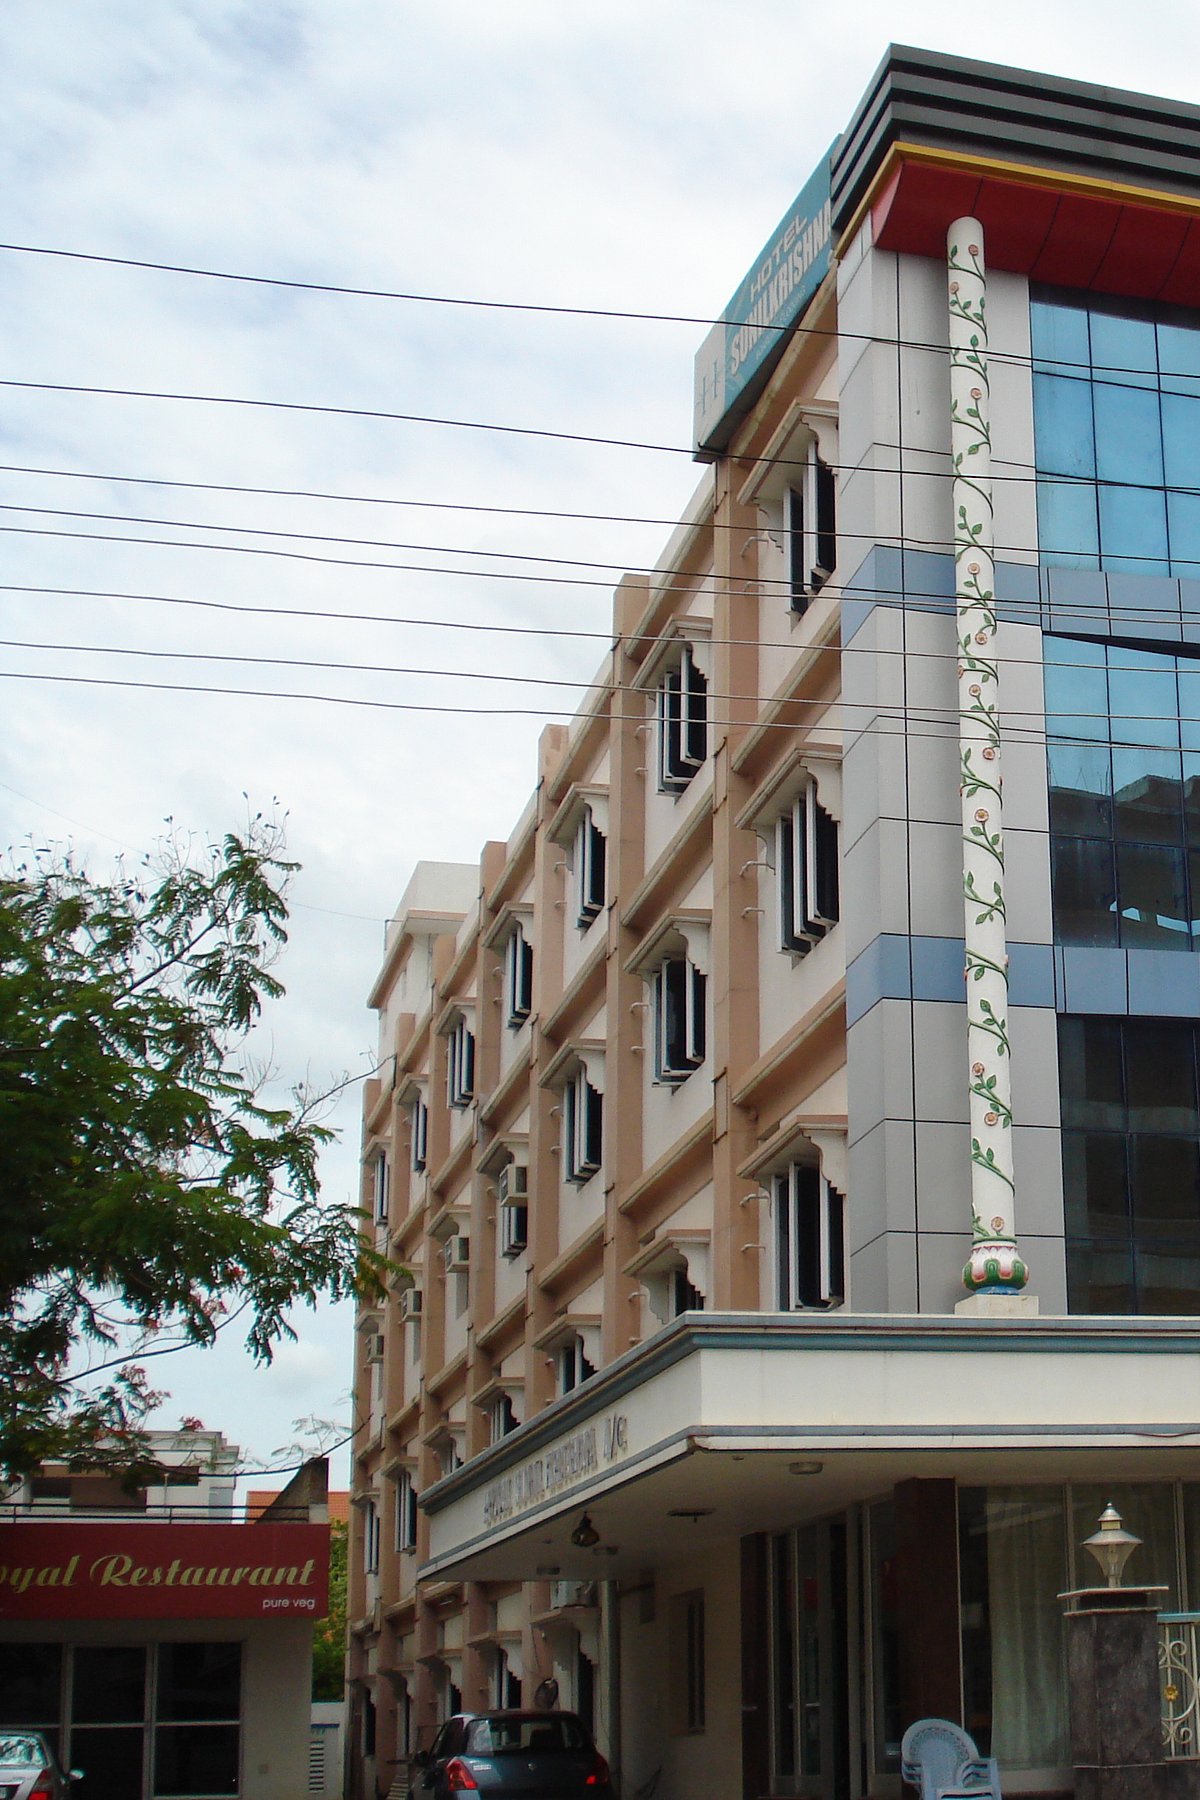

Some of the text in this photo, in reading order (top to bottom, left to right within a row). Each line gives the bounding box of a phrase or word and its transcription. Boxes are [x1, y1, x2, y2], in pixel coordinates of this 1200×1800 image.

[751, 213, 808, 300] HOTEL
[89, 1554, 315, 1588] Restaurant
[262, 1598, 316, 1610] pure veg
